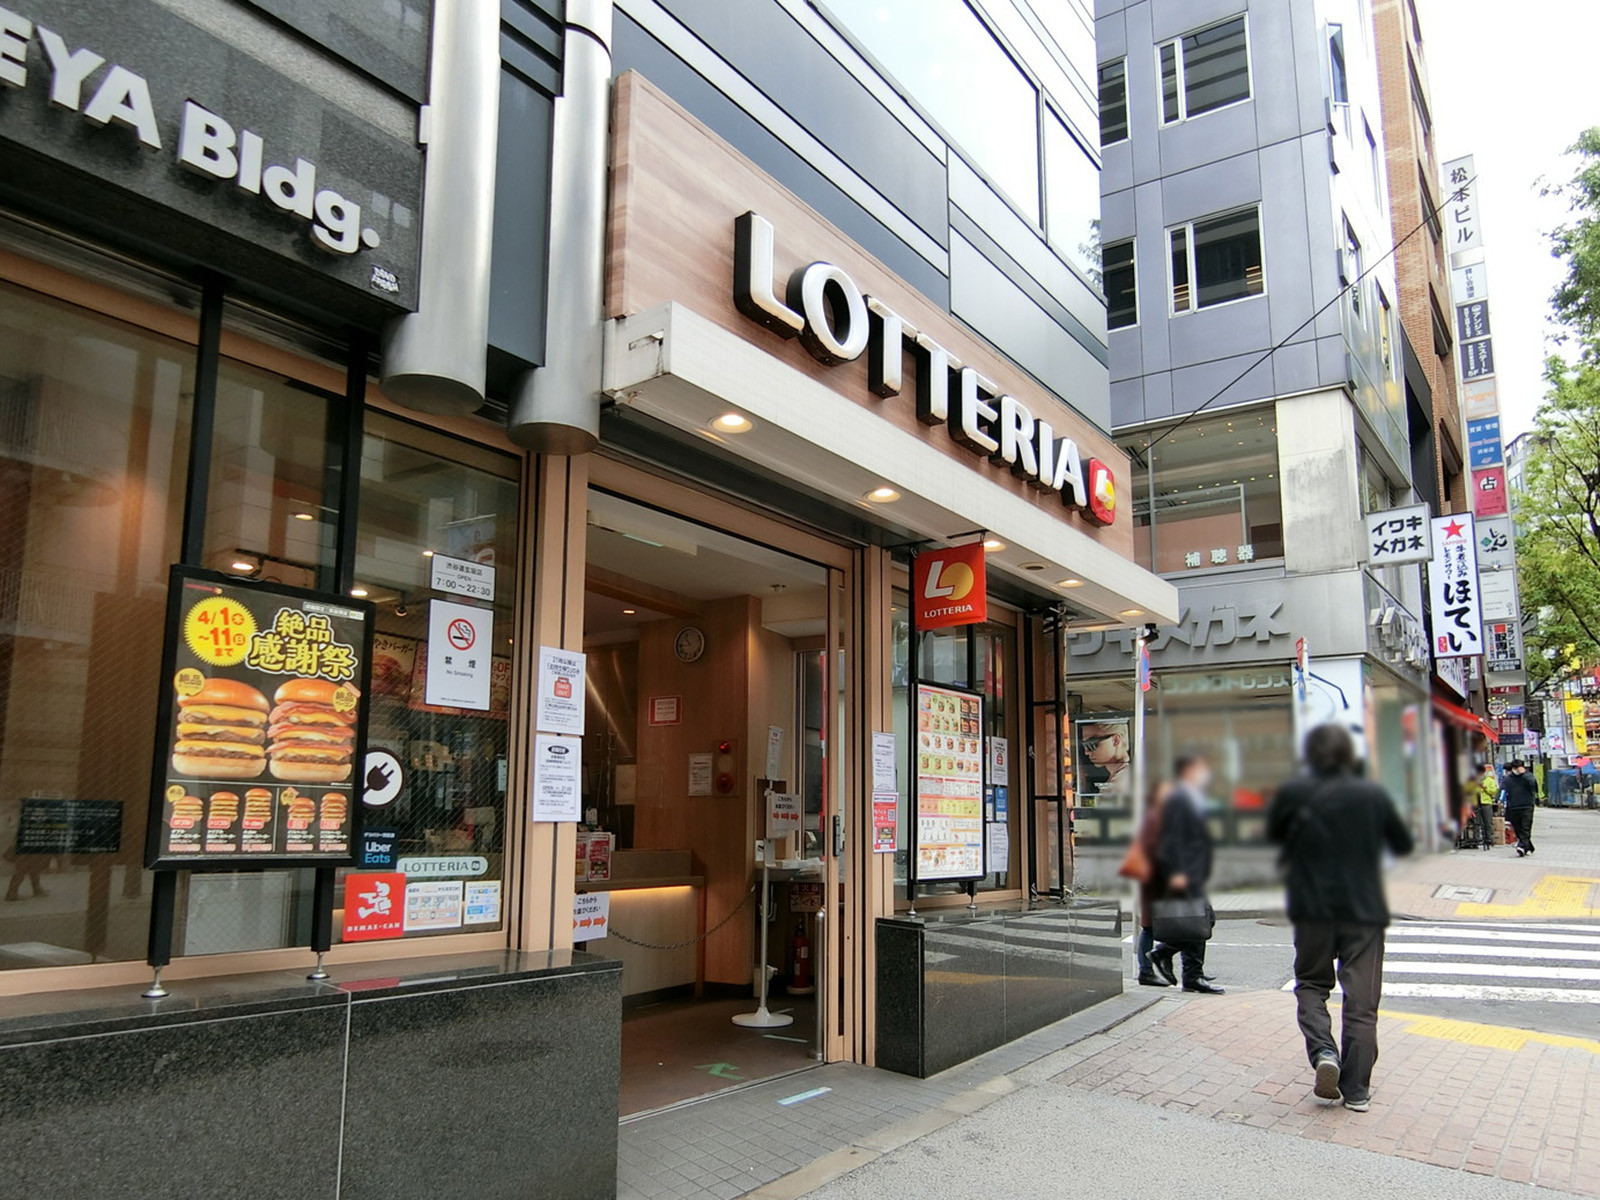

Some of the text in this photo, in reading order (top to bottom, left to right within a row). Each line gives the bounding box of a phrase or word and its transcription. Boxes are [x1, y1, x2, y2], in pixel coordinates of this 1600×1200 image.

[0, 7, 381, 255] EYA Bldg.
[1450, 167, 1474, 244] 松本ビル
[735, 211, 1087, 509] LOTTERIA
[1478, 341, 1489, 374] エステート
[1371, 515, 1423, 537] イワキ
[1185, 544, 1254, 568] 補聴器
[1373, 535, 1425, 557] メガネ
[1444, 547, 1454, 580] レモンサワー
[1455, 545, 1470, 578] 牛煮込み
[456, 574, 473, 583] OPEN
[924, 604, 973, 619] LOTTERIA
[1444, 579, 1477, 652] ほてい
[276, 610, 332, 644] 絶品
[214, 647, 234, 658] まで
[248, 632, 358, 679] 感謝祭
[444, 655, 477, 670] 禁煙
[453, 670, 474, 679] Smoking
[364, 853, 391, 864] Eats
[365, 841, 392, 853] Uber
[403, 860, 469, 873] LOTTERIA
